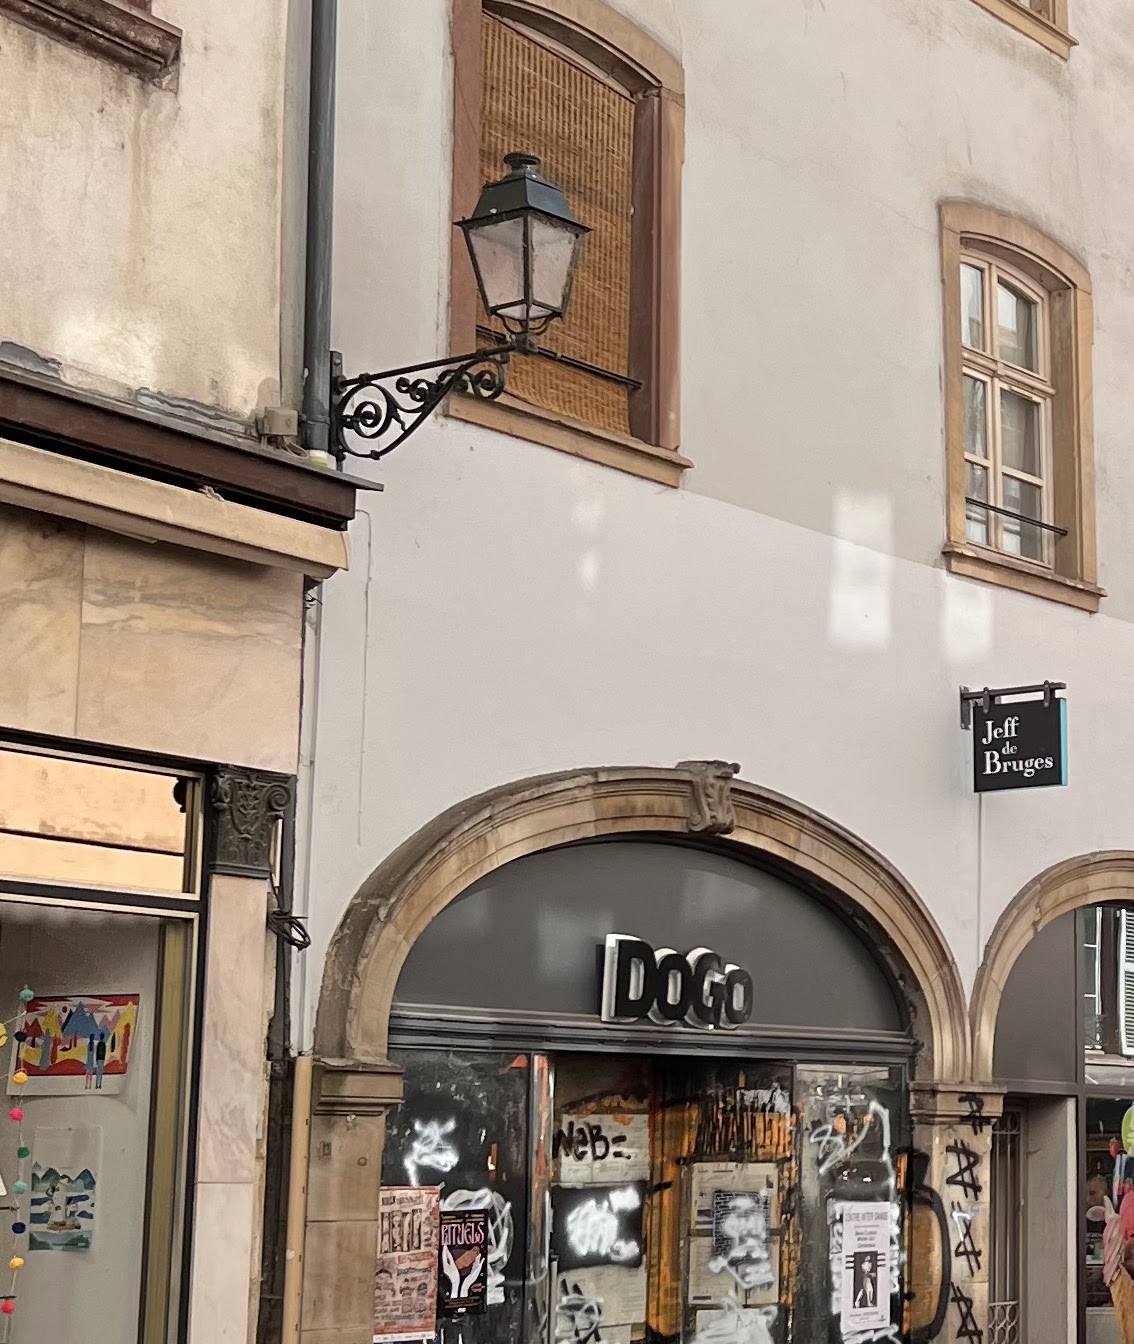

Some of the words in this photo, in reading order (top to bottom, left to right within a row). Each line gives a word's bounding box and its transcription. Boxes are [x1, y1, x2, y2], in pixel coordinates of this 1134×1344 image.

[982, 716, 1020, 745] Jeff
[1001, 740, 1018, 755] de
[982, 750, 1054, 777] Bruges
